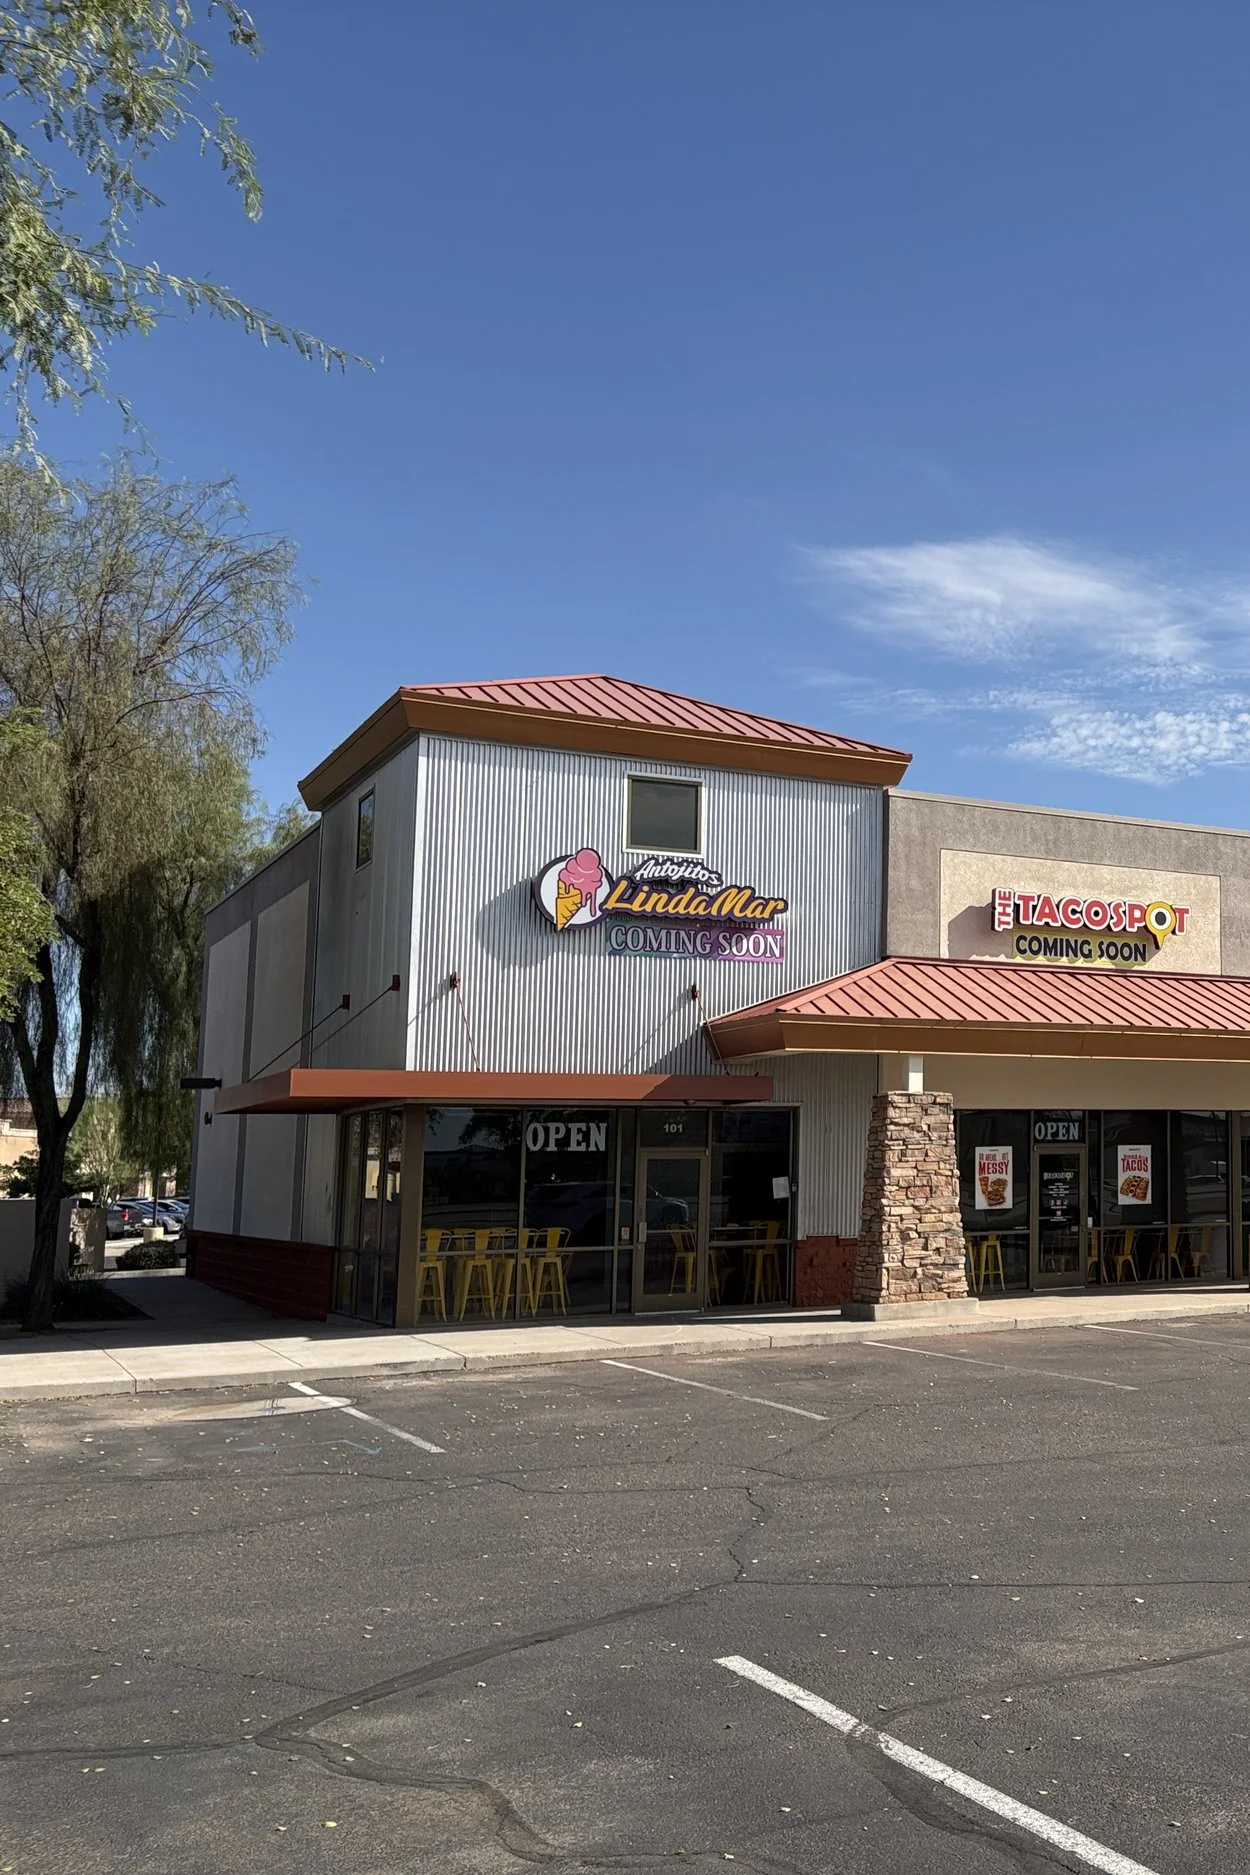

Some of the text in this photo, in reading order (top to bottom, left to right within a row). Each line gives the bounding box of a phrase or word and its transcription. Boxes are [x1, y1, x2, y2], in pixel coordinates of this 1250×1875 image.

[634, 859, 721, 885] Antojitos
[995, 888, 1014, 930] THE
[610, 926, 782, 958] COMING SOON
[1015, 935, 1147, 963] COMING SOON
[526, 1121, 608, 1152] OPEN
[663, 1123, 684, 1134] 101
[1034, 1121, 1080, 1141] OPEN
[978, 1160, 1009, 1176] MESSY
[1121, 1156, 1148, 1173] TACOS
